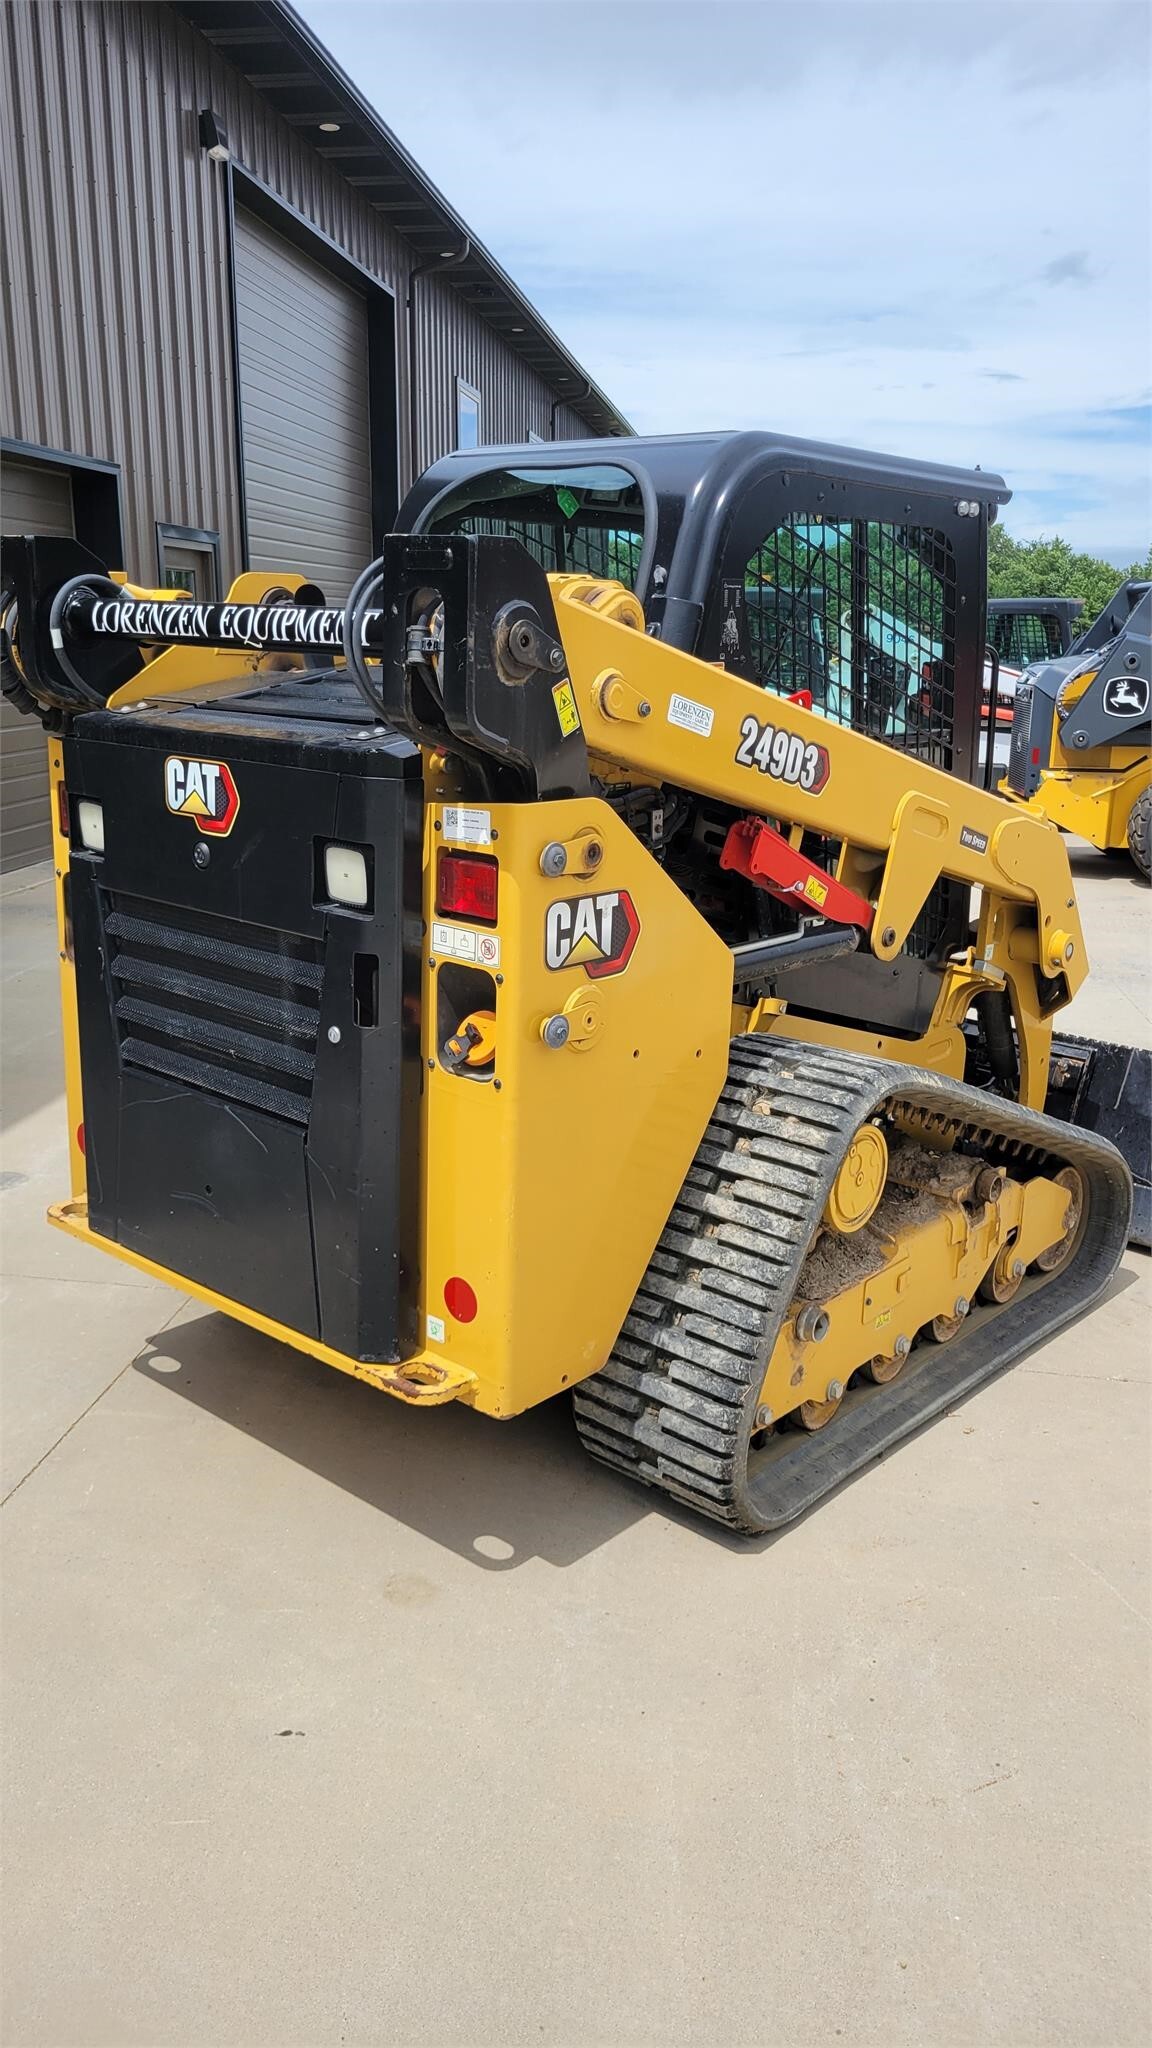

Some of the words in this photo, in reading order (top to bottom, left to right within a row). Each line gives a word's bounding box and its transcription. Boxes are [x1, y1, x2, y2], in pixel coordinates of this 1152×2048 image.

[92, 601, 214, 637] LORENZEN
[673, 699, 711, 721] LORENZEN
[736, 717, 818, 788] 249D3
[167, 759, 220, 816] CAT
[547, 893, 619, 968] CAT
